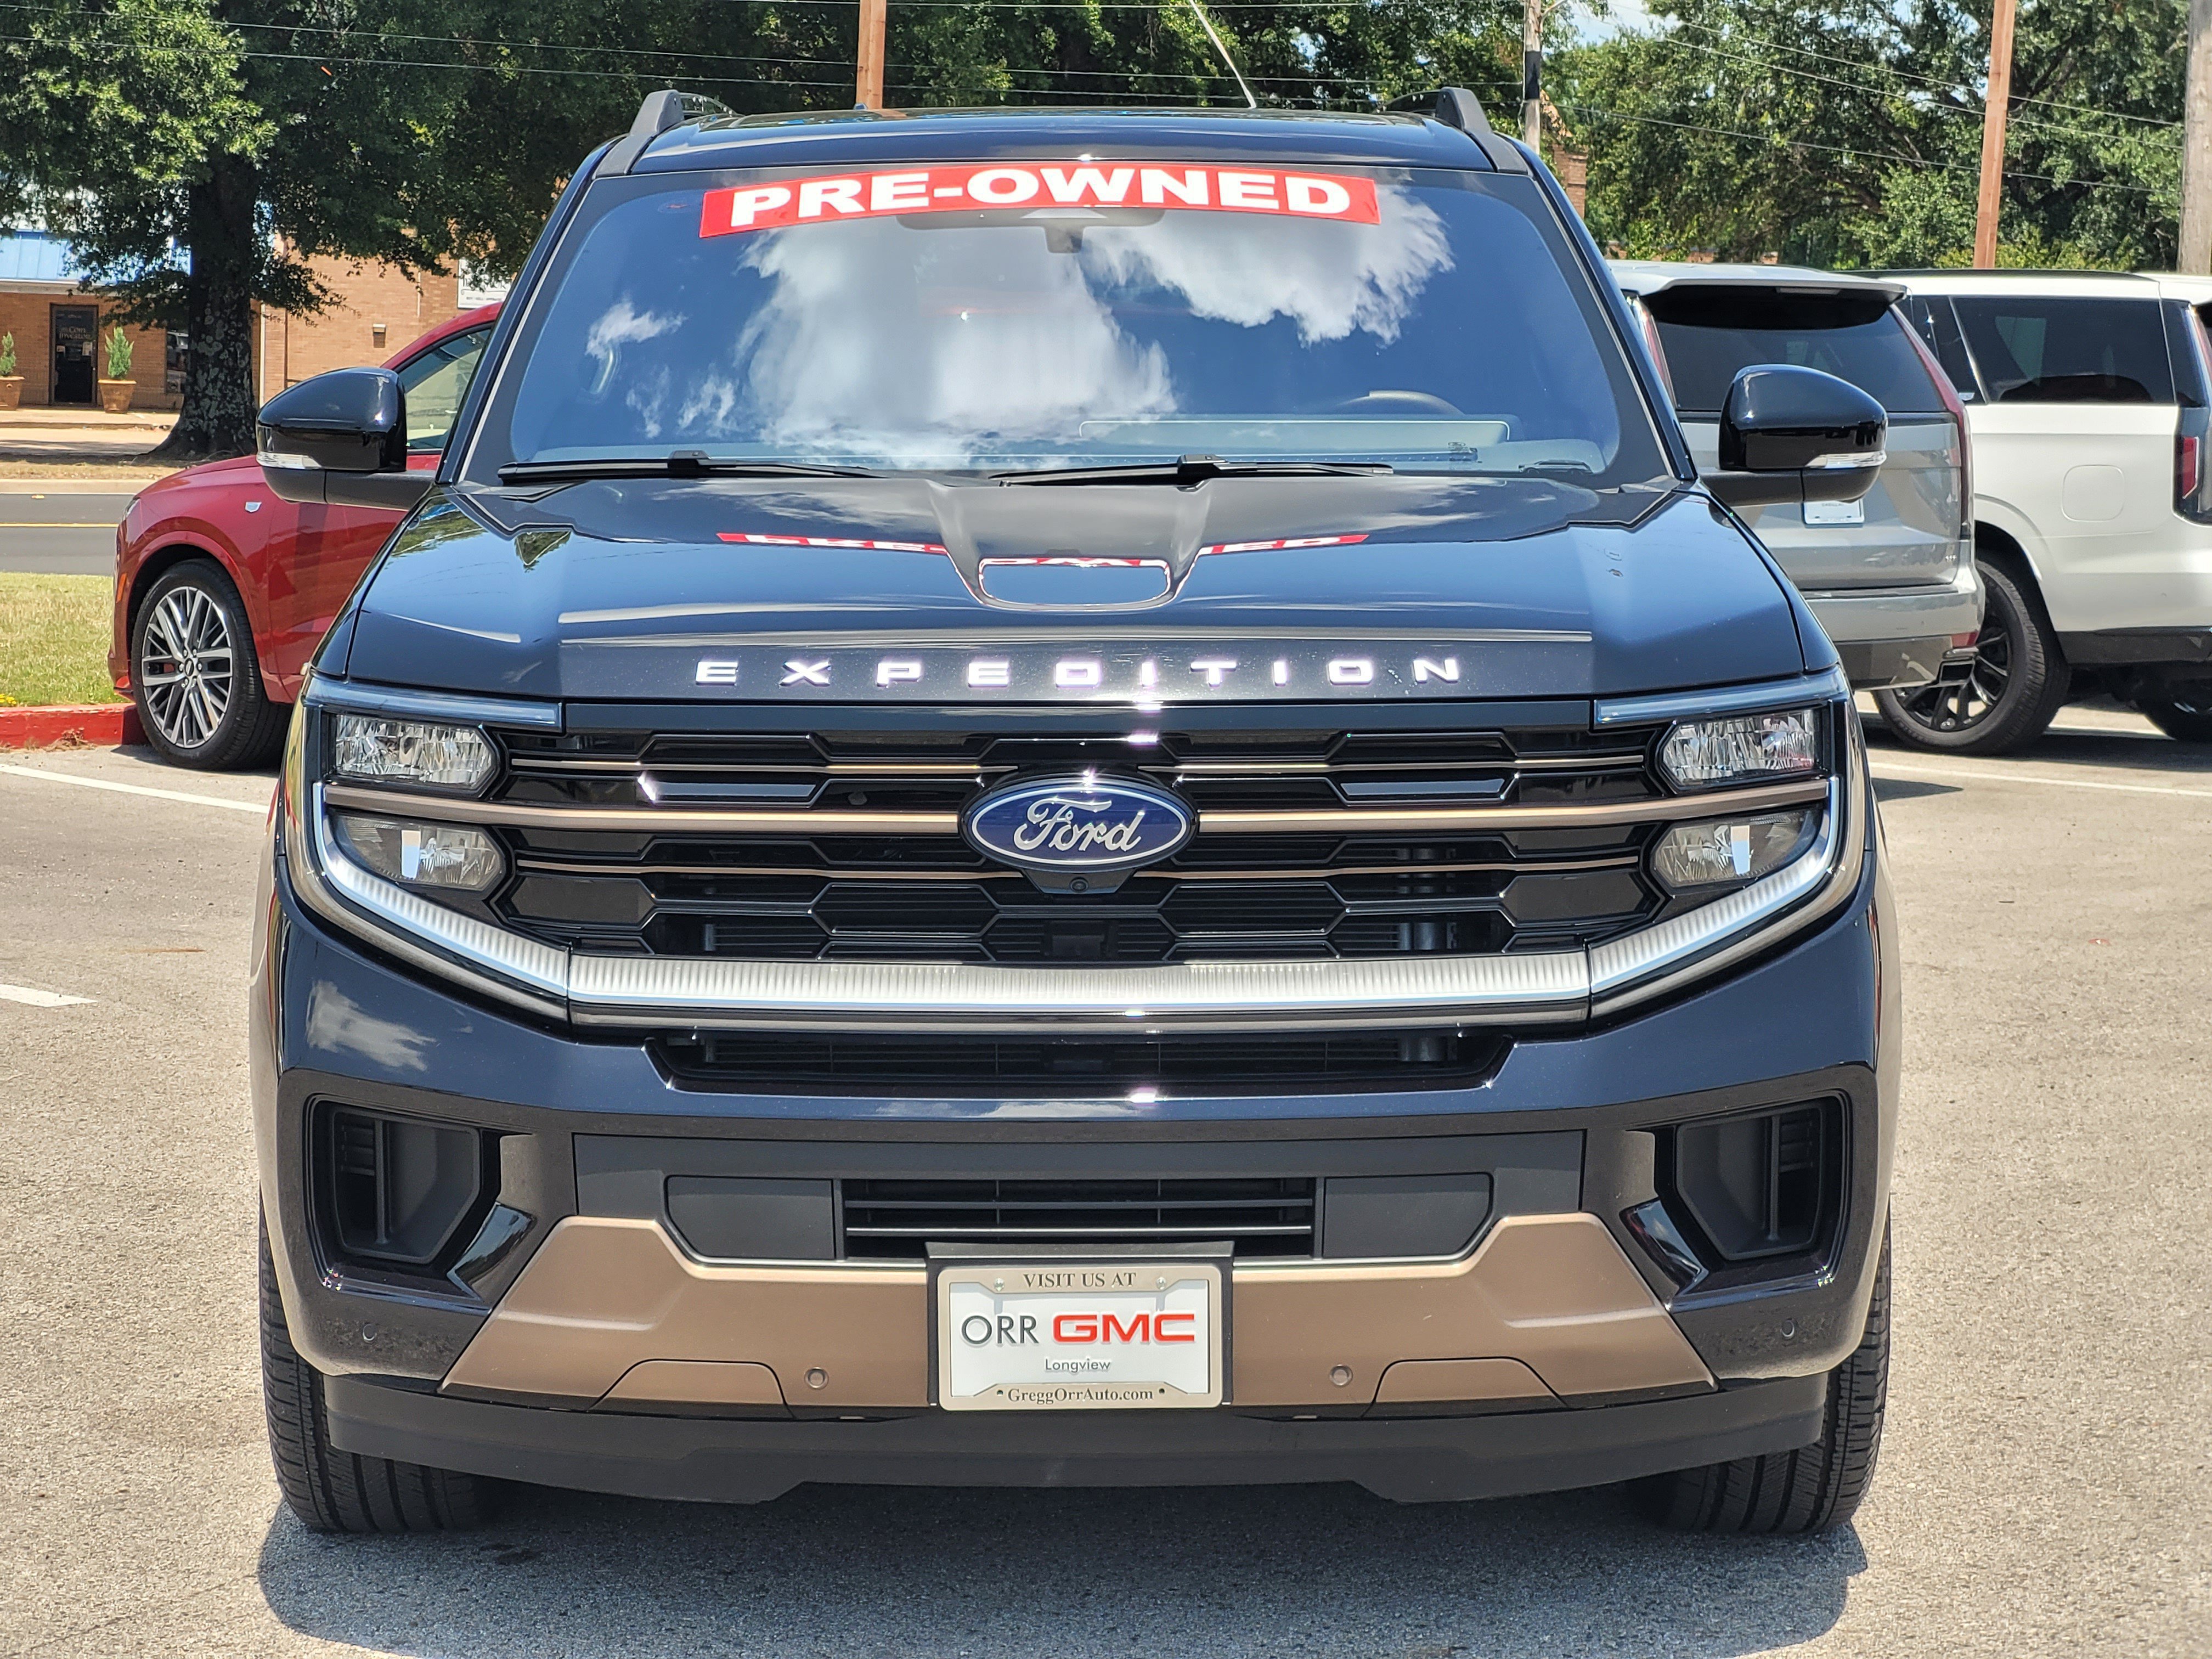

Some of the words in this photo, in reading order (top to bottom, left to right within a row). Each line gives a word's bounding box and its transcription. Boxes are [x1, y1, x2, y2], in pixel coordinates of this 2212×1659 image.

[730, 168, 1350, 227] PRE-OWNED
[695, 659, 1459, 688] EXPEDITION
[1014, 798, 1145, 851] Ford
[1024, 1273, 1075, 1288] VISIT
[1082, 1272, 1105, 1287] US
[1111, 1272, 1137, 1286] AT
[961, 1314, 1040, 1344] ORR
[1053, 1313, 1195, 1342] GMC
[1045, 1358, 1111, 1373] Longview
[1008, 1387, 1154, 1405] GreggOrrAuto.com
